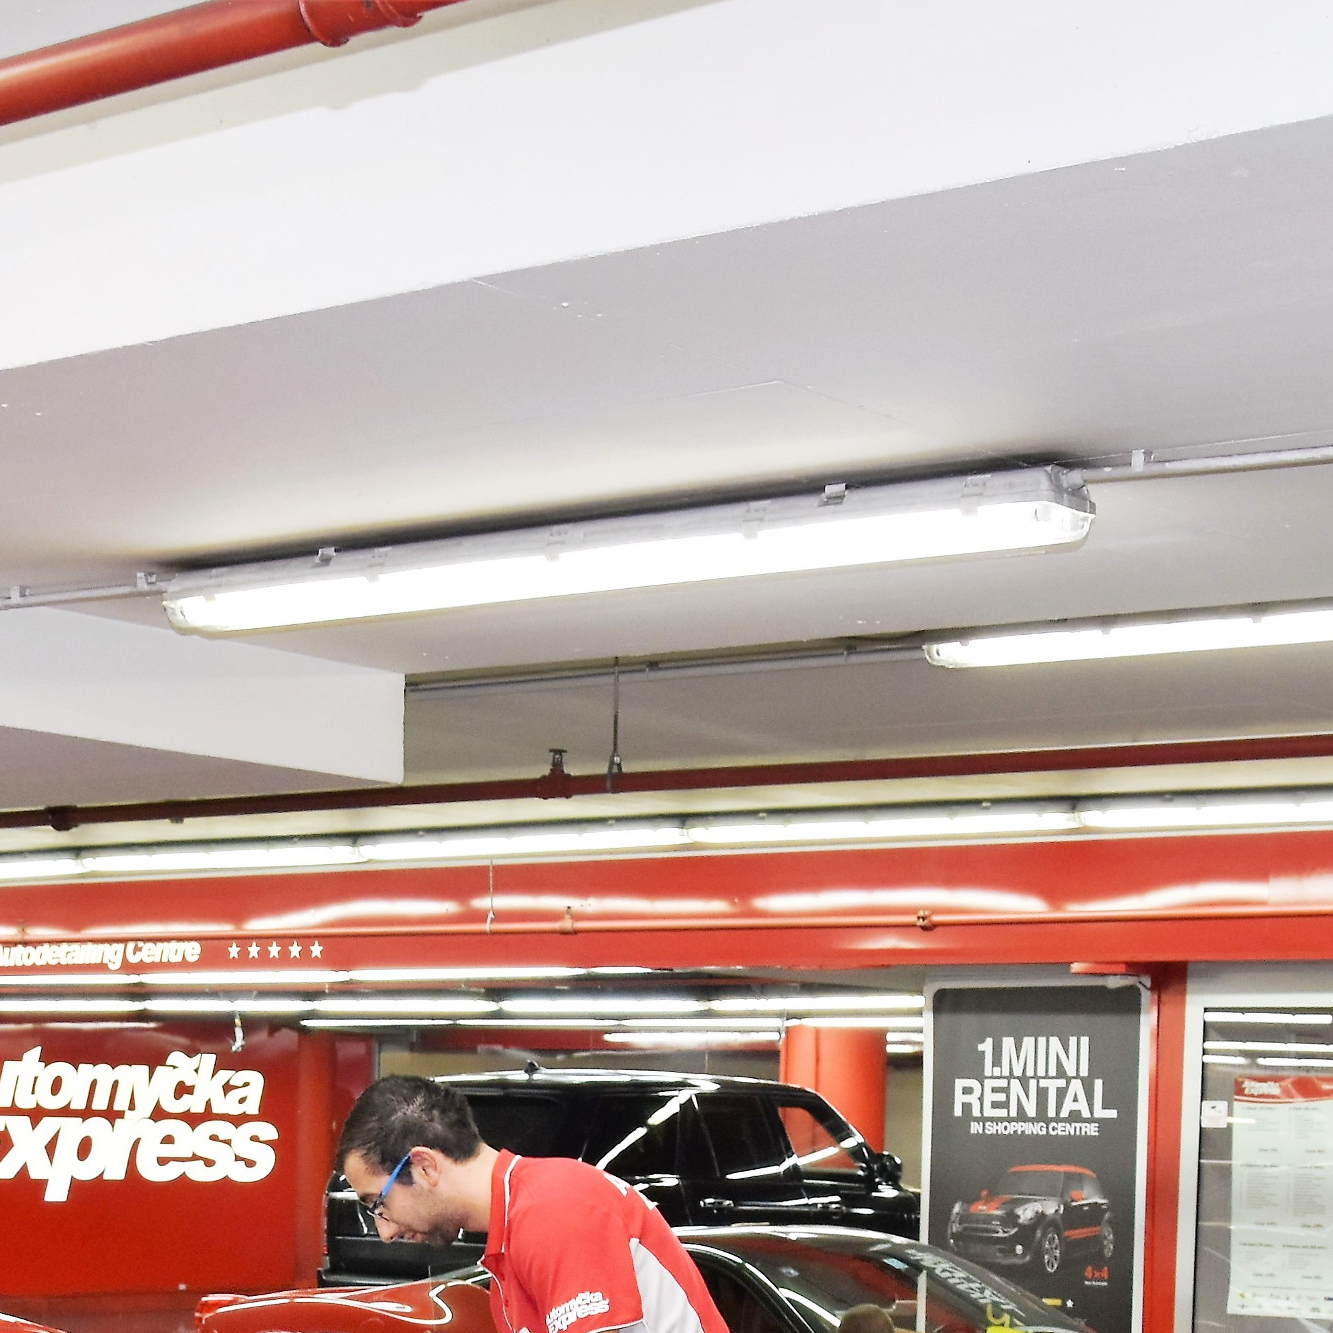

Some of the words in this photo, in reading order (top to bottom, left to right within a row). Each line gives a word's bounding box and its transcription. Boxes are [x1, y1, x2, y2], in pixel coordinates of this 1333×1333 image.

[126, 941, 202, 963] Centre
[954, 1078, 1118, 1118] RENTAL
[970, 1121, 984, 1135] IN
[985, 1121, 1047, 1136] SHOPPING
[1048, 1122, 1100, 1136] CENTRE
